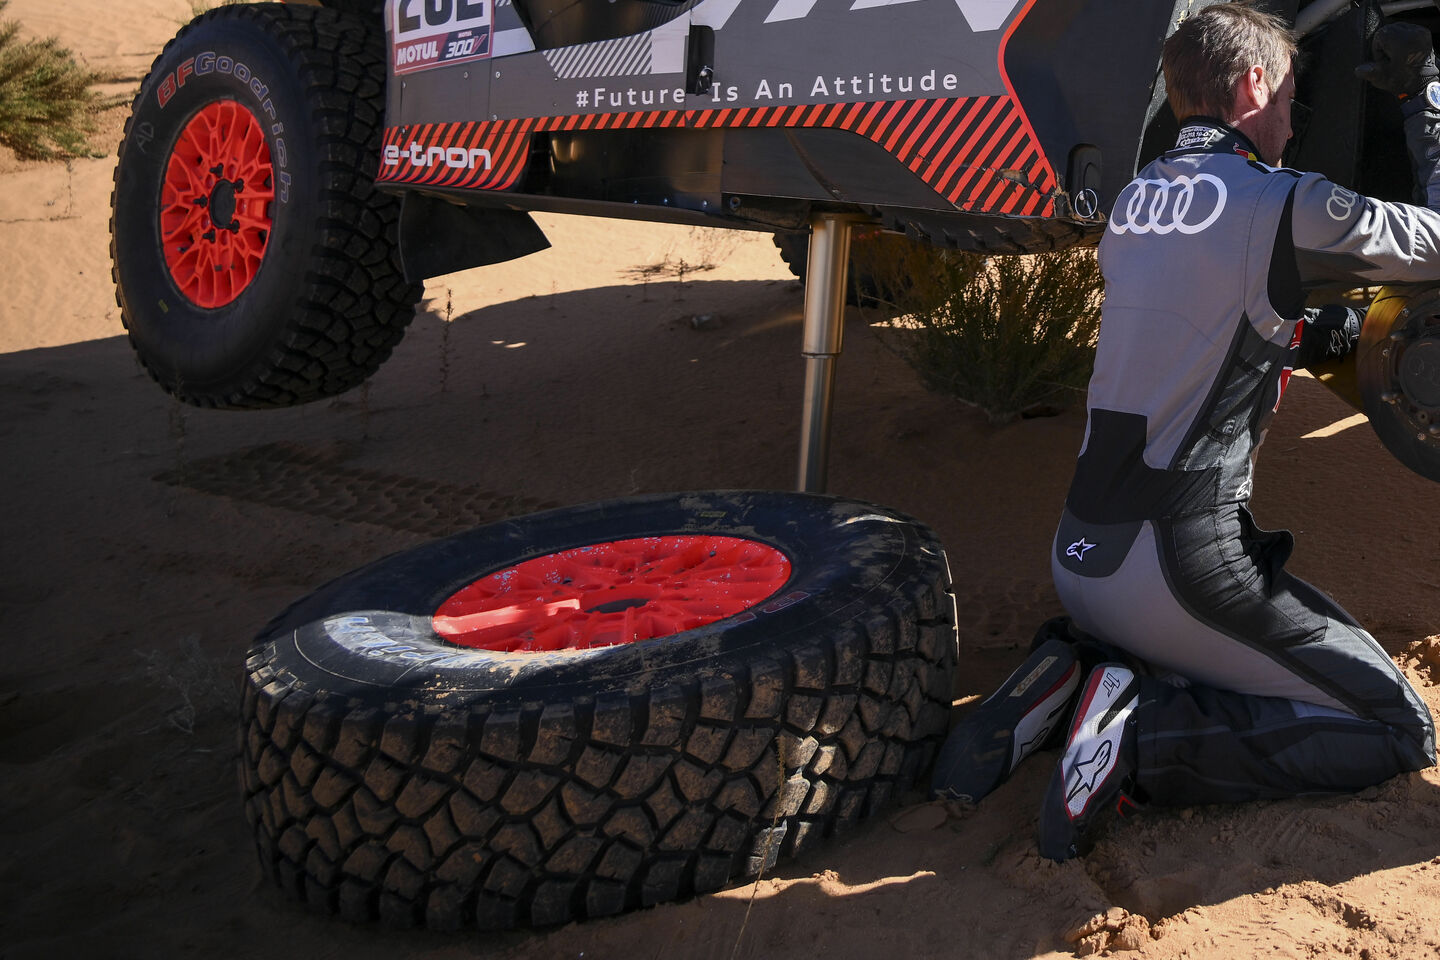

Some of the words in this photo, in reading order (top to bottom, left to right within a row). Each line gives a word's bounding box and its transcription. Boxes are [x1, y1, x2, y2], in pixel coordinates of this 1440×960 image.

[396, 40, 439, 66] MOTUL
[445, 33, 488, 58] 300V
[576, 86, 687, 108] #Future
[711, 80, 739, 103] Is
[755, 78, 794, 101] An
[810, 68, 959, 97] Attitude
[157, 51, 292, 204] BFGoodrich
[383, 140, 492, 171] e-tron
